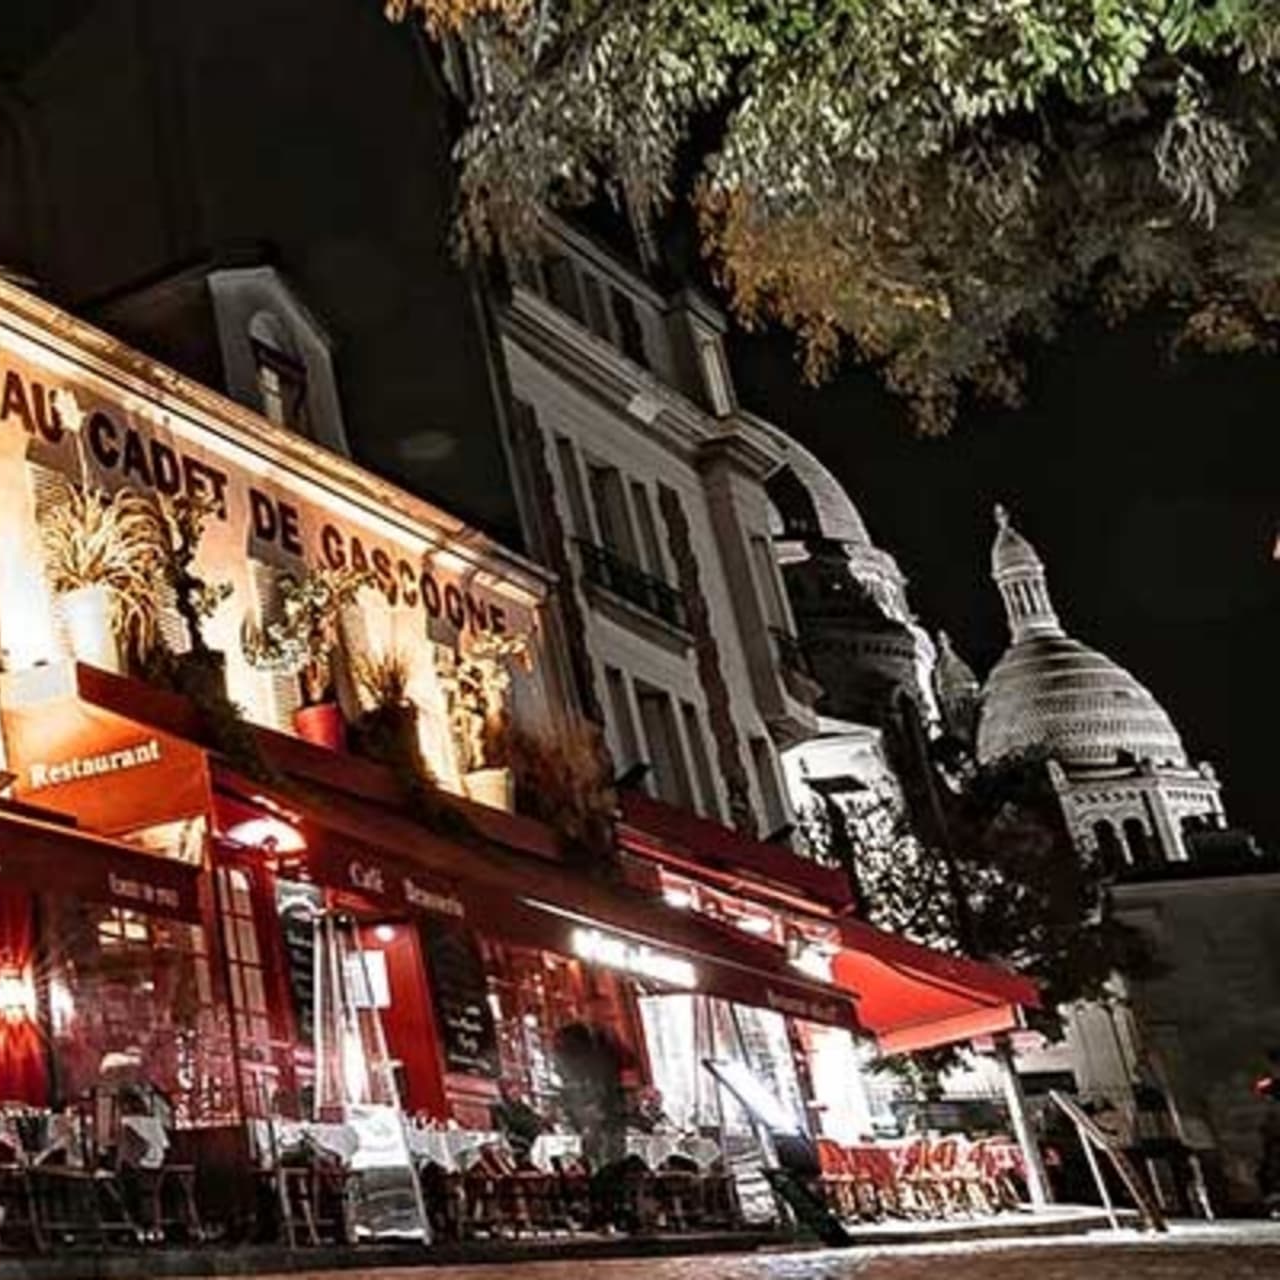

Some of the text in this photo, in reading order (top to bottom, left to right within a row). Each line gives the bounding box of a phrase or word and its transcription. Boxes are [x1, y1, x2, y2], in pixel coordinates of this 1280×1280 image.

[0, 370, 507, 636] AU CADET DE GASCOGNE
[30, 740, 161, 789] Restaurant
